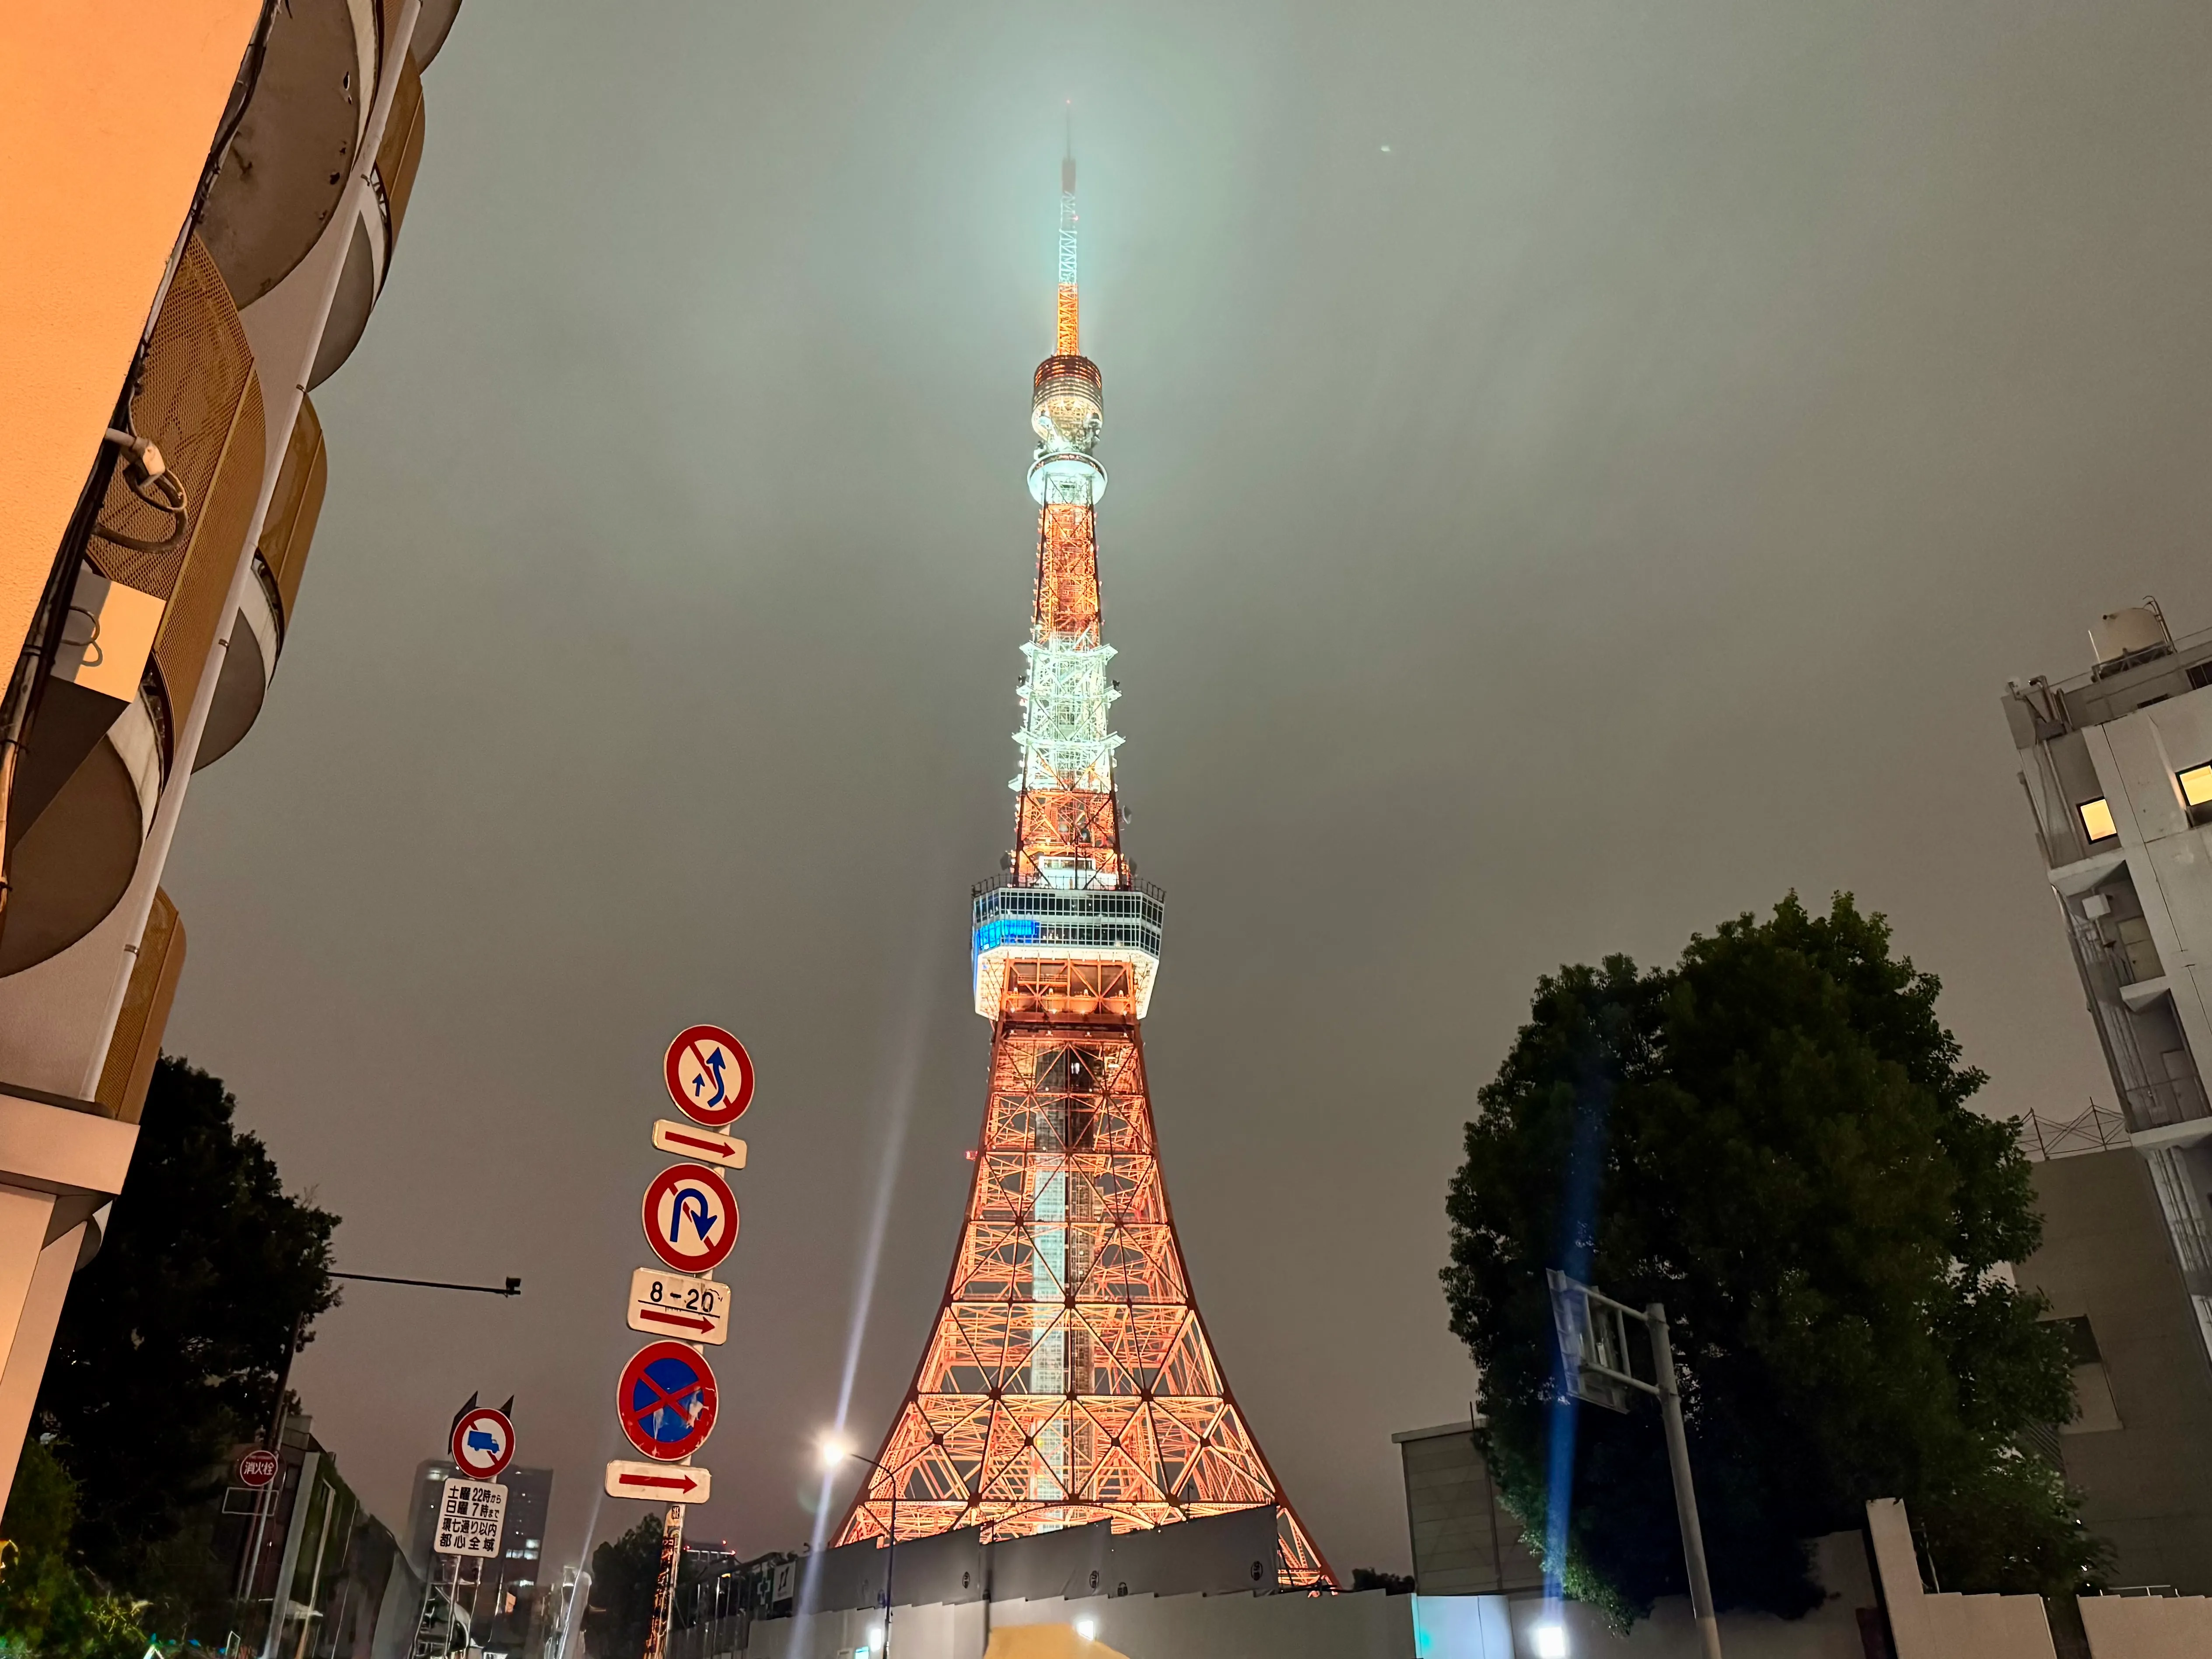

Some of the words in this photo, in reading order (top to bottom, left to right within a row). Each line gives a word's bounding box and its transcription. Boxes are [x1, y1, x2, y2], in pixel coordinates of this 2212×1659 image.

[650, 1281, 714, 1312] 8-20
[244, 1462, 274, 1475] 消火栓
[442, 1518, 497, 1537] 環七通り以内
[440, 1533, 495, 1552] 都心全域
